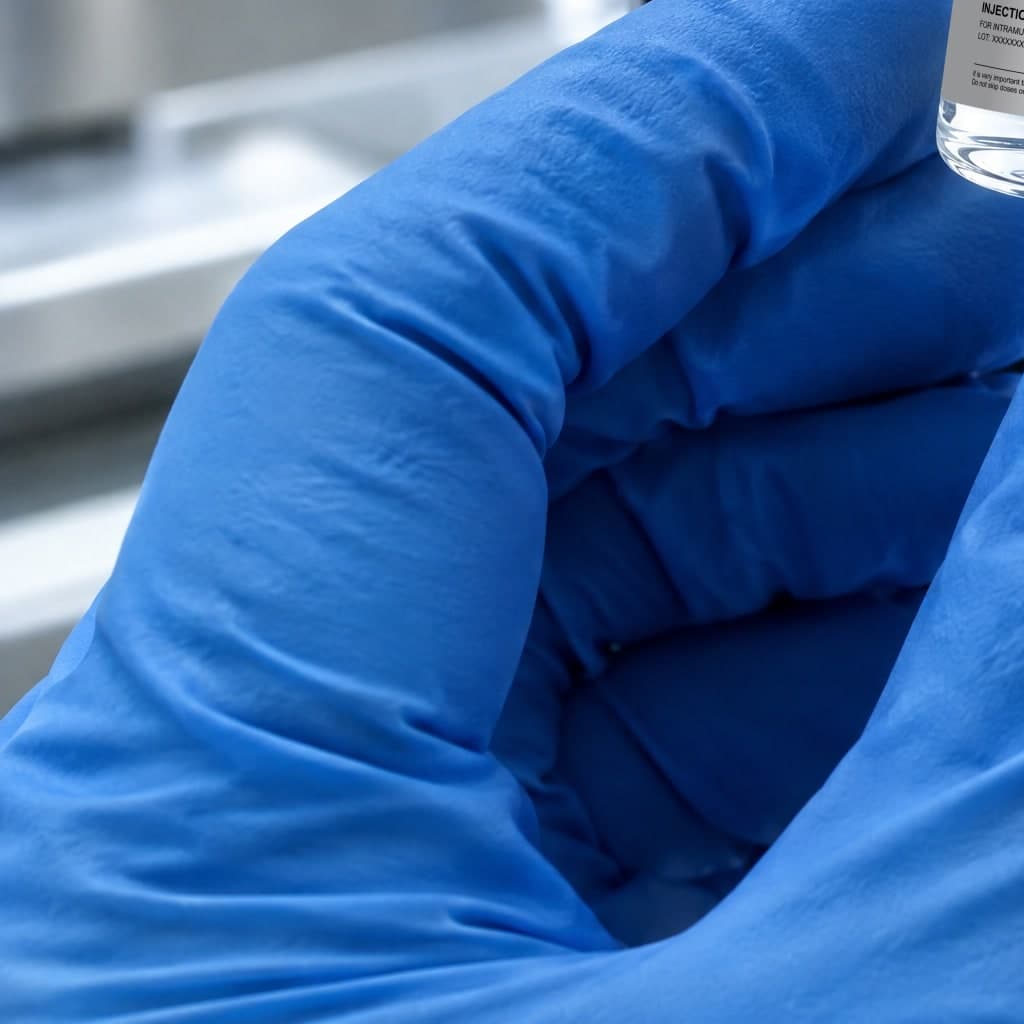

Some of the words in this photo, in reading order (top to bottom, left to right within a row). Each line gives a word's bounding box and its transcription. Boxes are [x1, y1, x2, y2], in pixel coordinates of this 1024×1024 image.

[979, 19, 992, 30] FOR
[993, 74, 1020, 85] important
[979, 80, 987, 88] not
[999, 84, 1018, 94] doses
